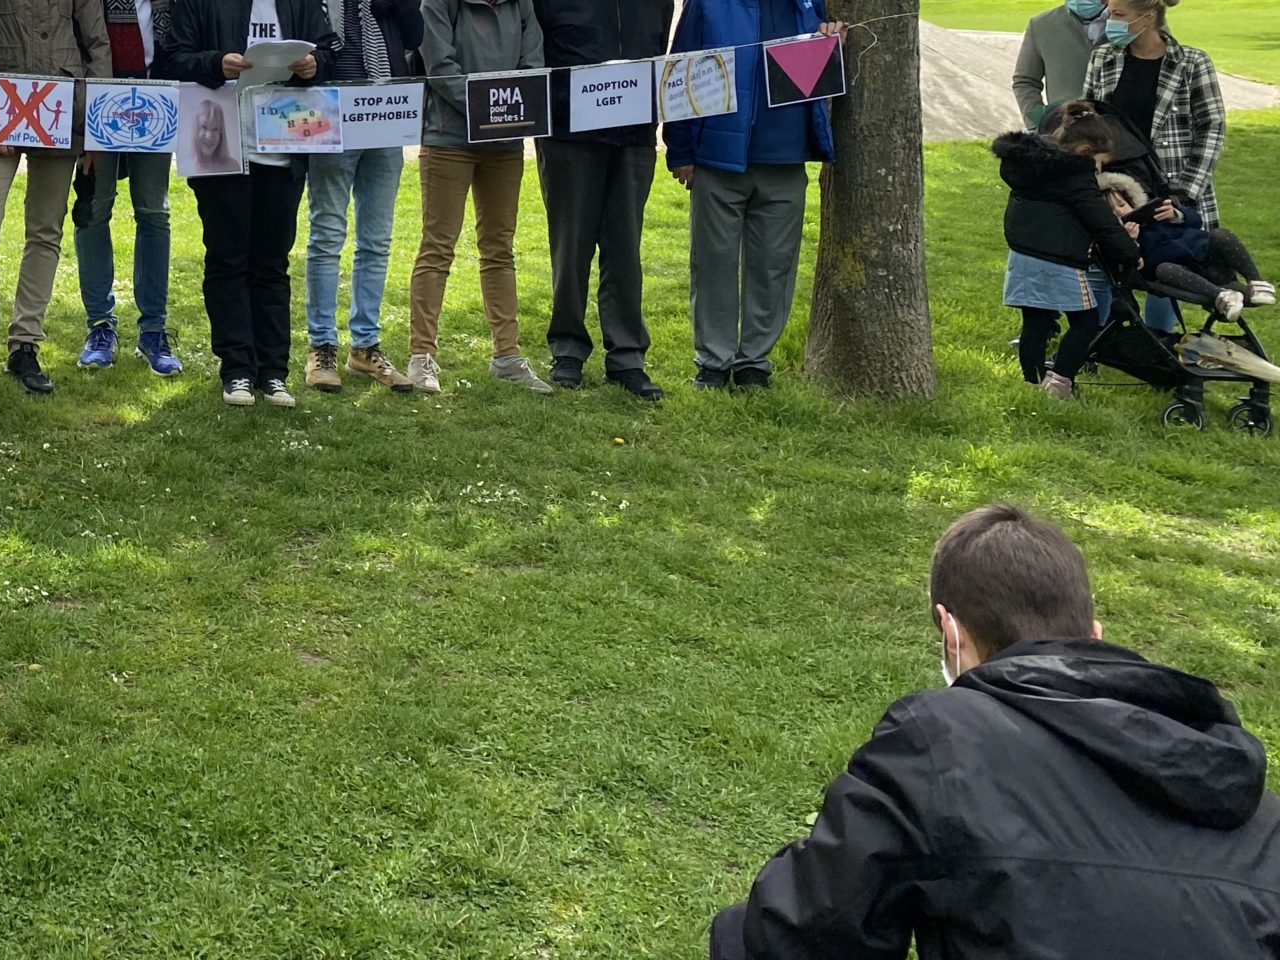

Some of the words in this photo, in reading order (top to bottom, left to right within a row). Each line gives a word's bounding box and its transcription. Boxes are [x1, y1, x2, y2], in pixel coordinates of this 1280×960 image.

[251, 22, 276, 38] THE
[581, 78, 638, 94] ADOPTION
[667, 77, 684, 89] PACS
[353, 97, 382, 107] STOP
[385, 95, 409, 105] AUX
[489, 86, 523, 106] PMA
[596, 95, 623, 107] LGBT
[342, 109, 418, 122] LGBTPHOBIES
[489, 105, 508, 116] pour
[23, 134, 41, 143] Pou
